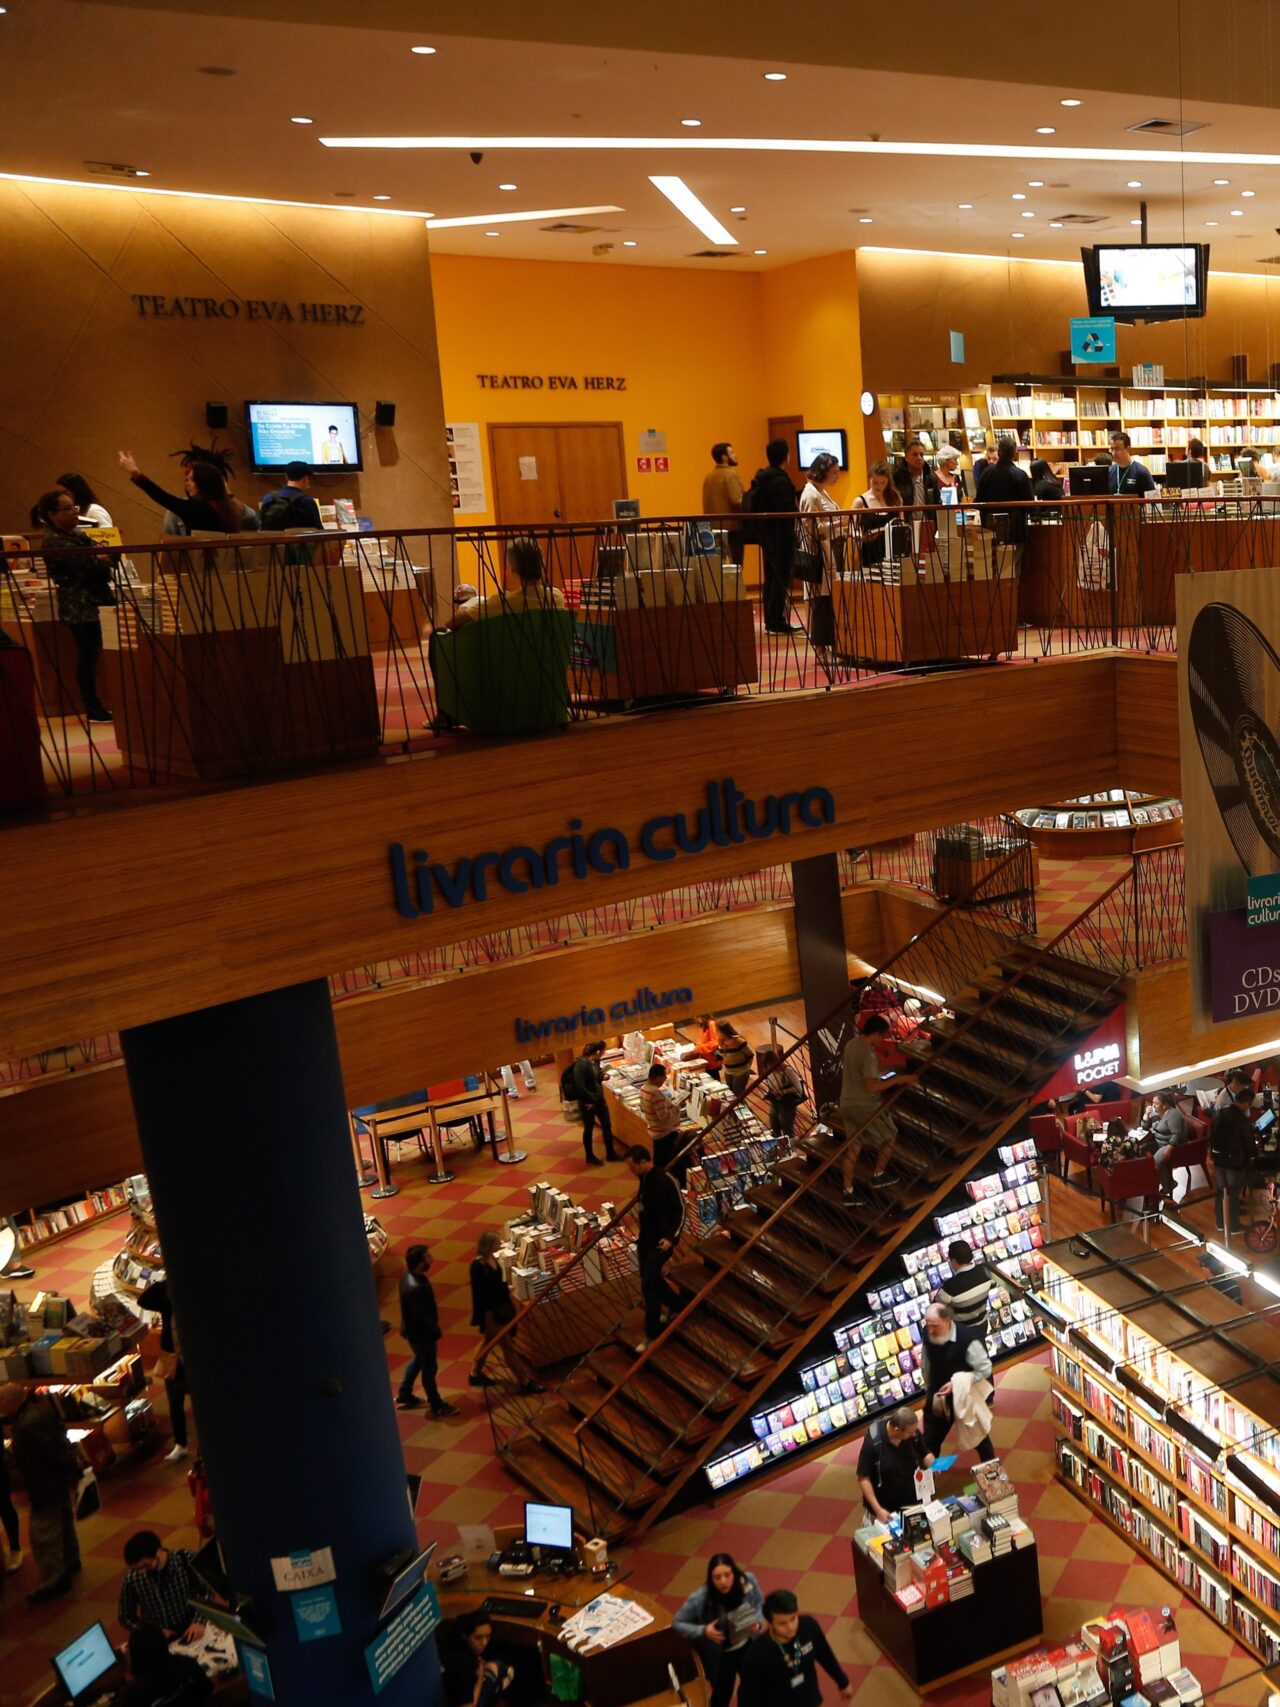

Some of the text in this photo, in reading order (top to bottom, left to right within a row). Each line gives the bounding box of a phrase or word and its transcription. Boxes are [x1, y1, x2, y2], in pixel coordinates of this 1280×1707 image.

[133, 294, 365, 324] TEATRO EVA HERZ
[477, 375, 627, 391] TEATRO EVA HERZ
[389, 777, 836, 918] livraria cultura
[1241, 966, 1280, 989] CDs
[514, 987, 694, 1043] livraria cultura
[1074, 1043, 1120, 1070] L&PM
[1077, 1060, 1120, 1085] POCKET
[283, 1566, 326, 1583] CAIXA
